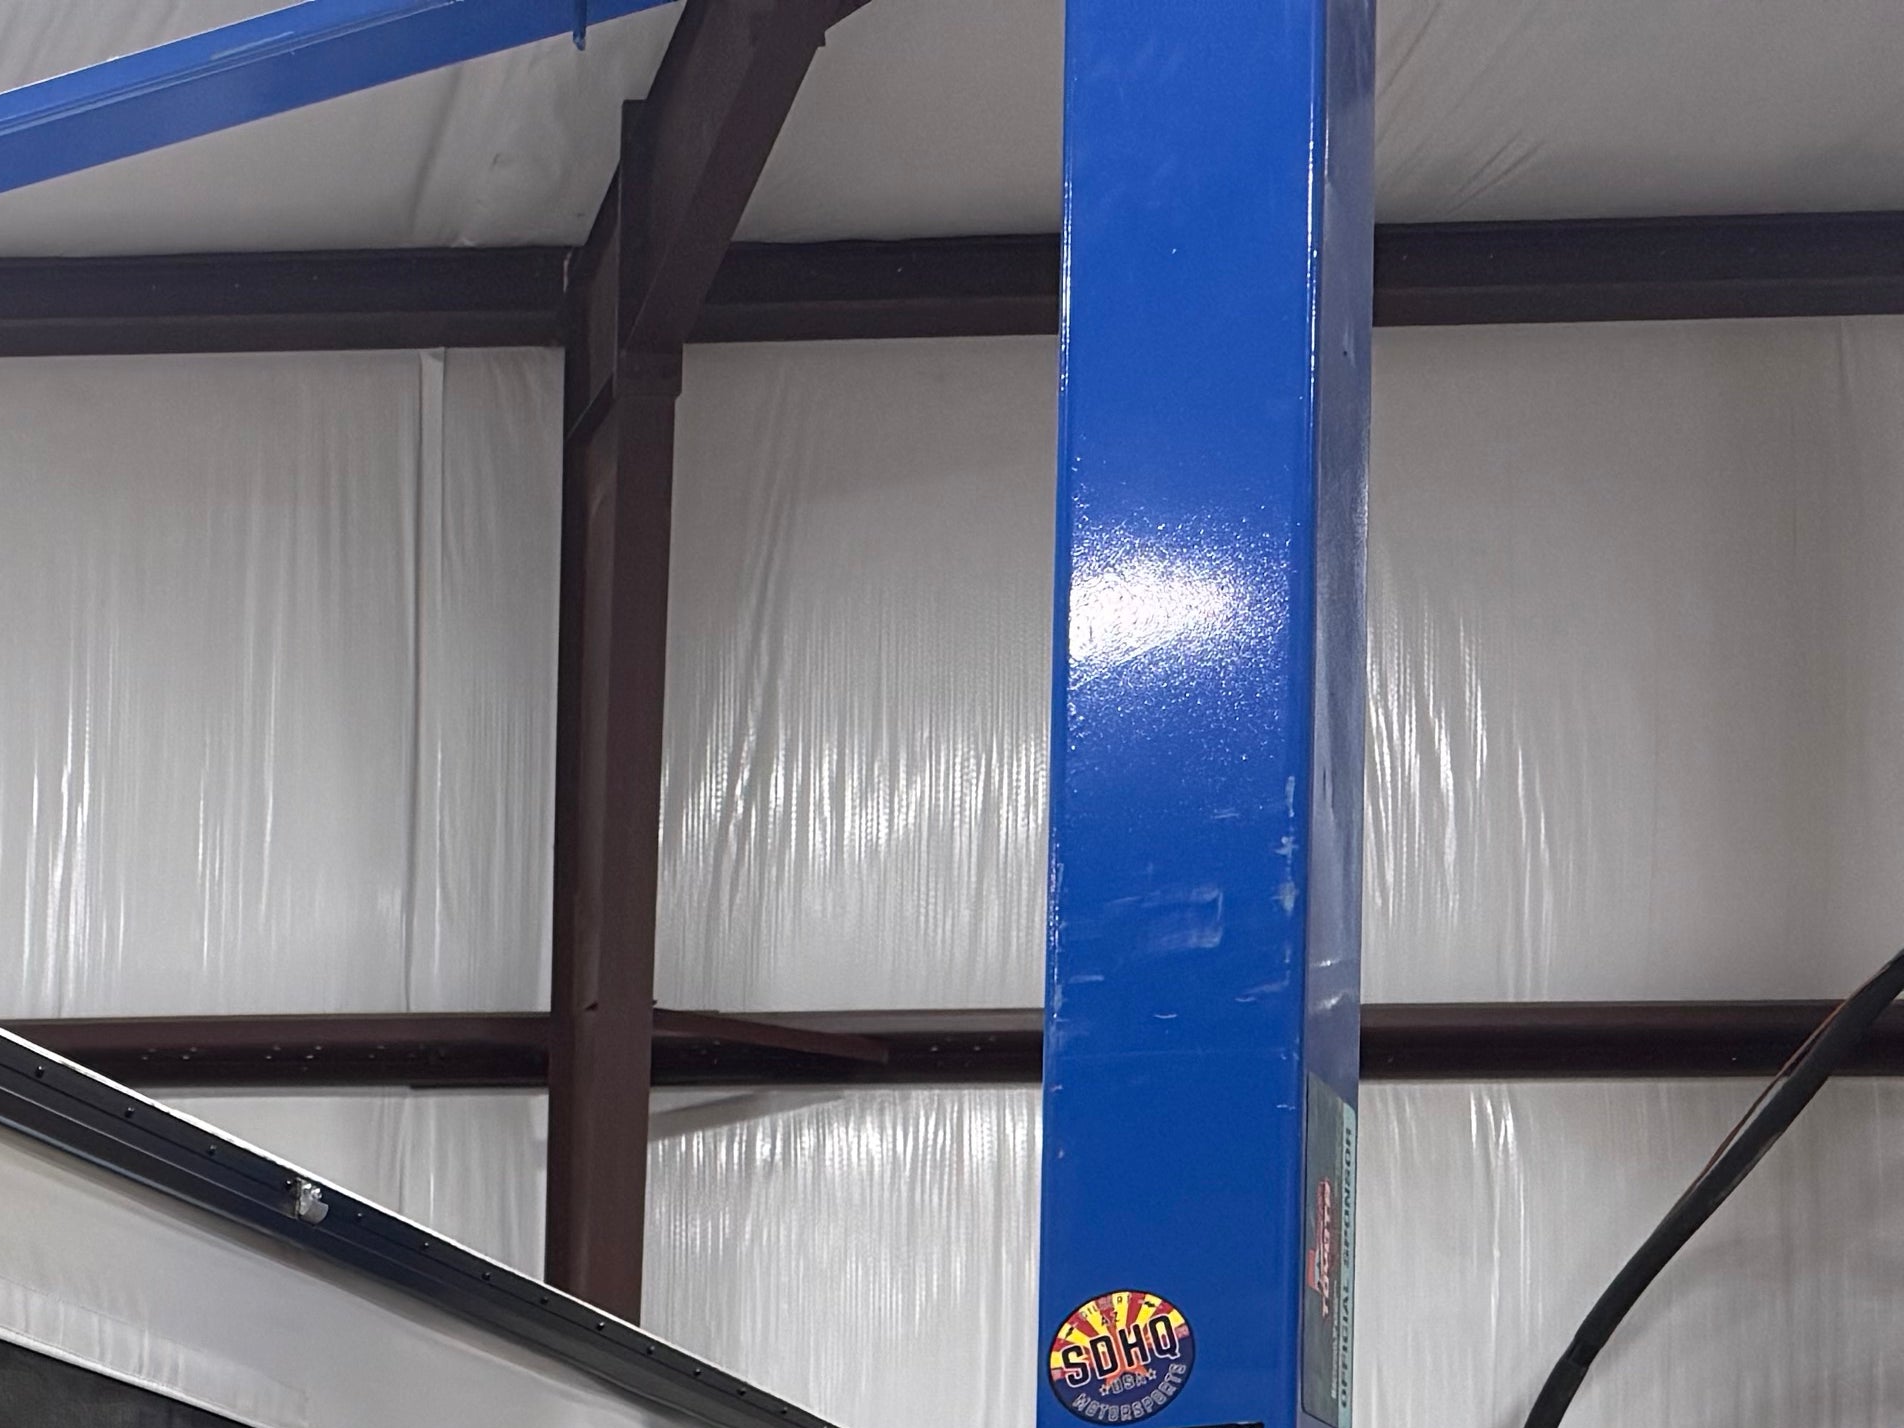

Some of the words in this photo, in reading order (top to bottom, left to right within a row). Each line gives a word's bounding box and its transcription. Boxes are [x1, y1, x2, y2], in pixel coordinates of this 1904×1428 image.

[1061, 1314, 1180, 1388] SDHQ
[1072, 1363, 1187, 1422] MOTORSPORTS
[1111, 1371, 1147, 1395] USA
